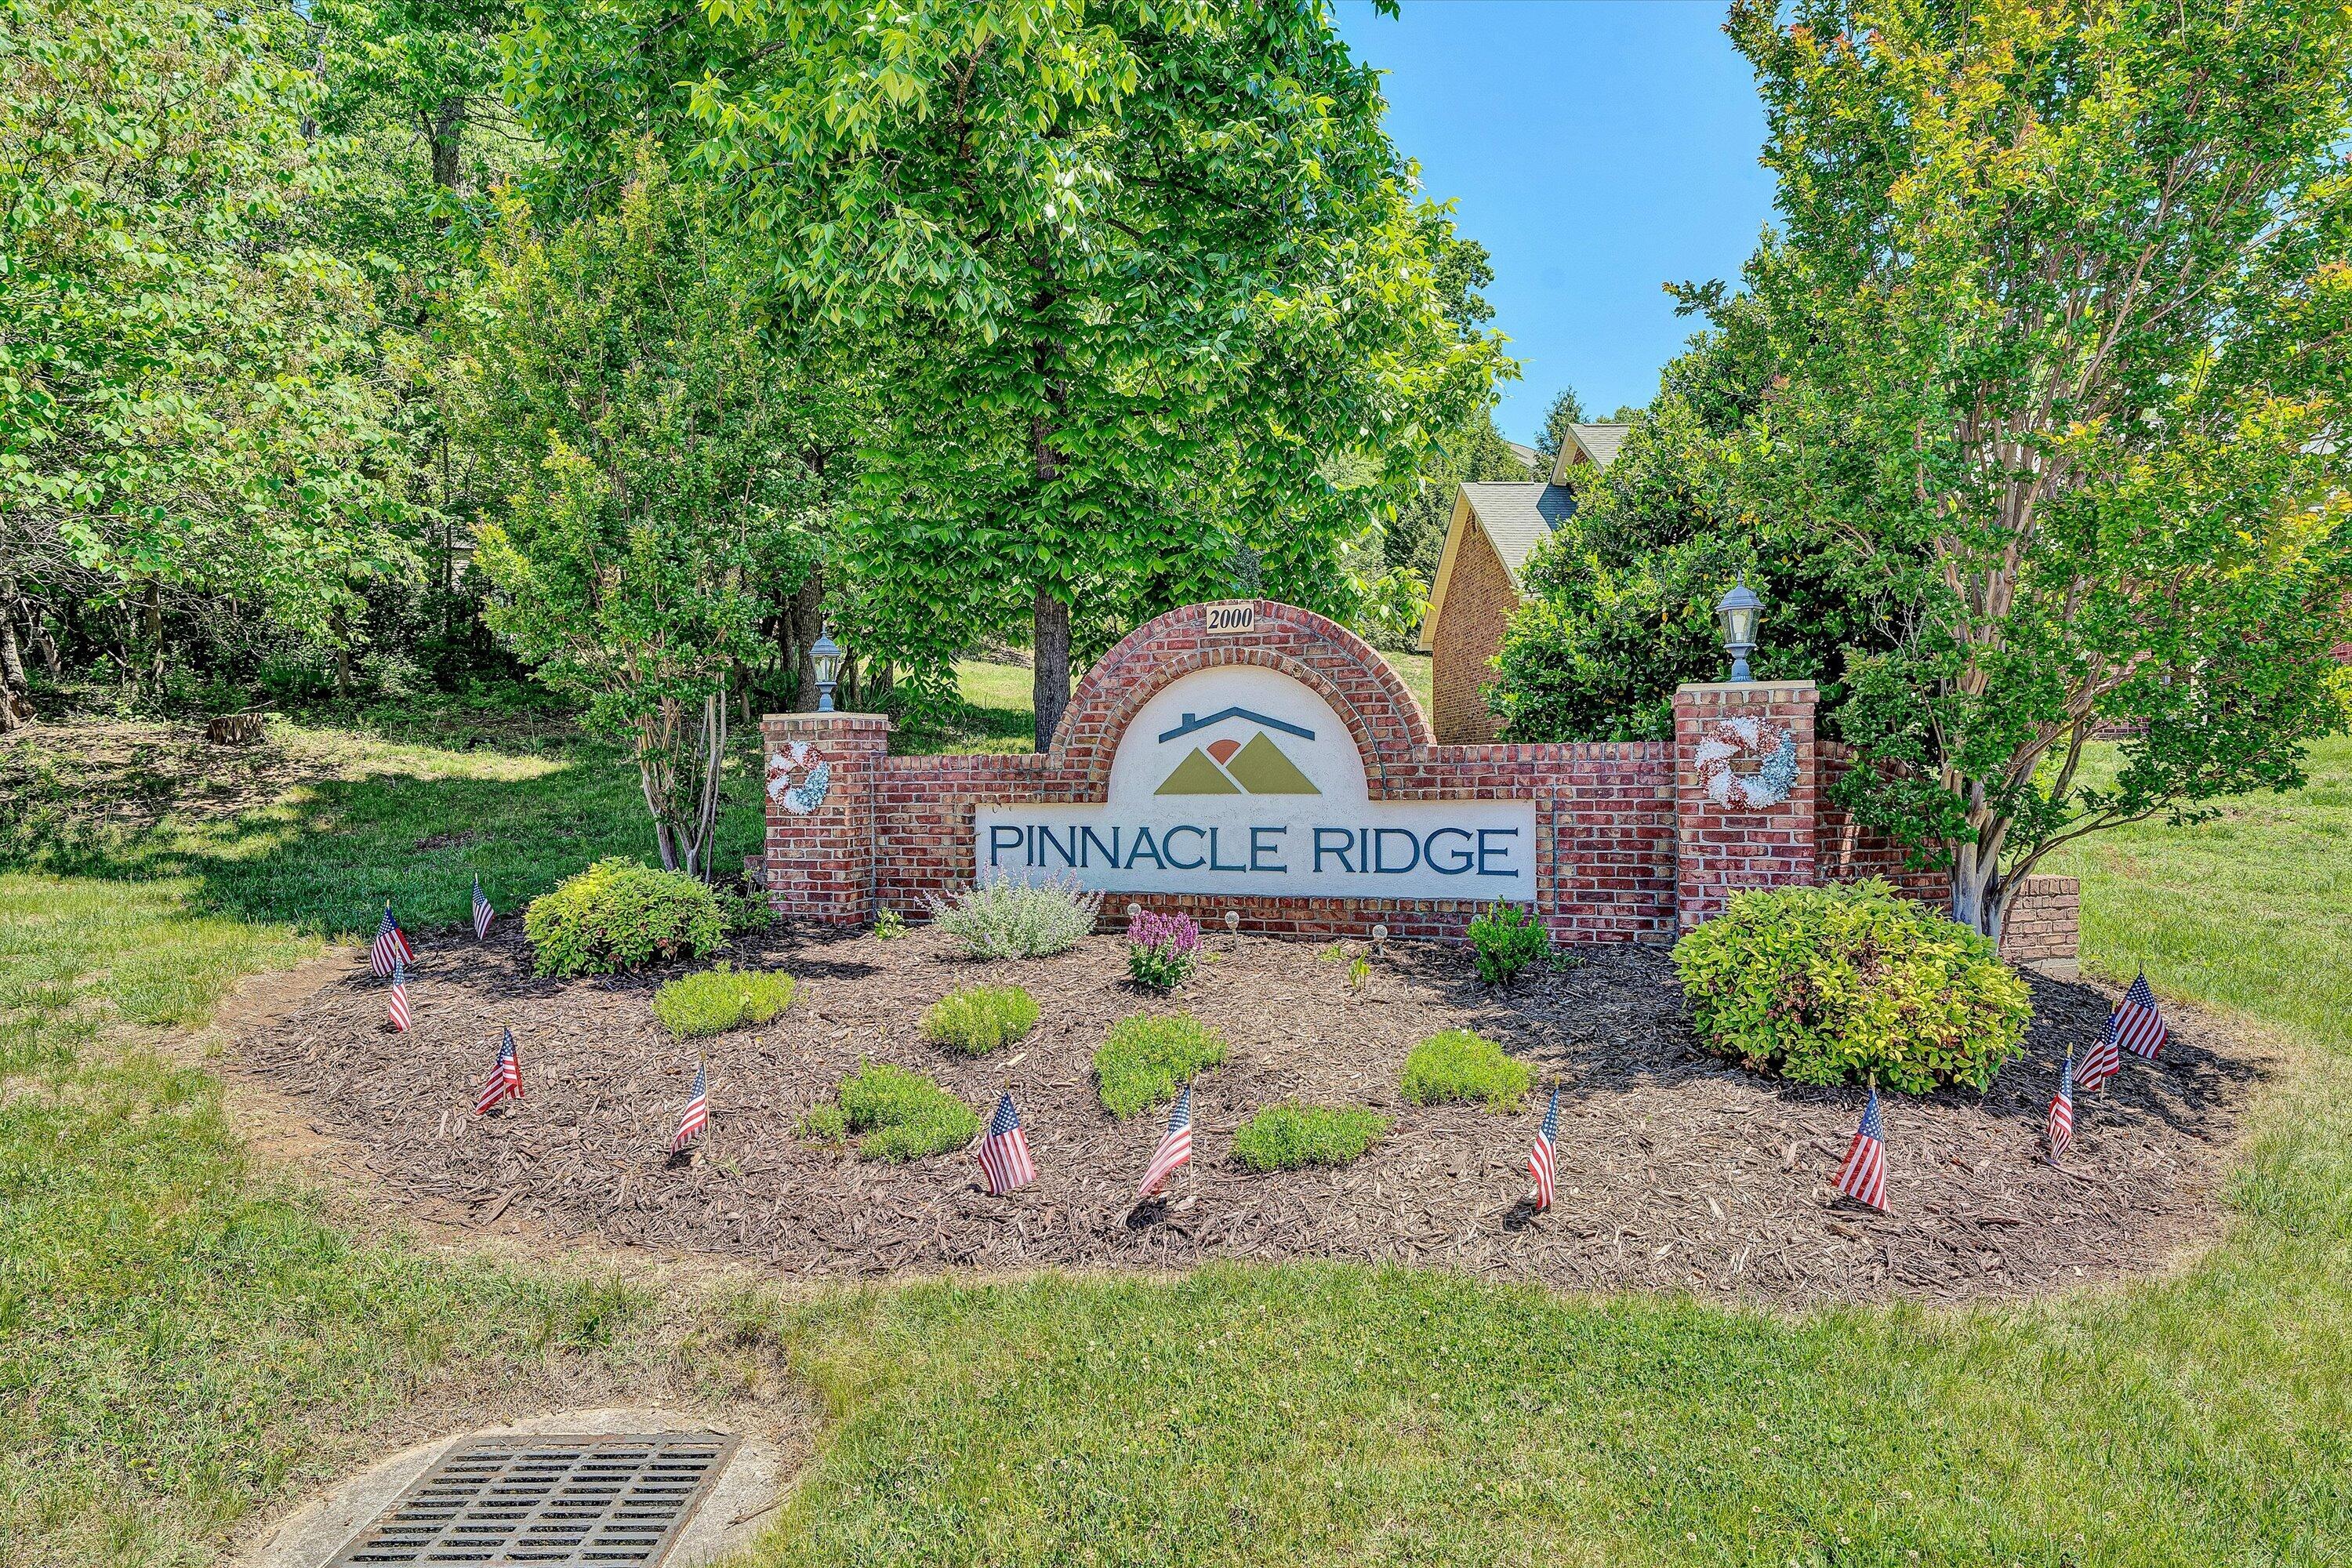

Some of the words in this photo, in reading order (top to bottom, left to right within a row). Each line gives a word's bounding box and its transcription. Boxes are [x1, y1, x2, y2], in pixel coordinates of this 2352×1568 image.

[1208, 608, 1253, 629] 2000
[990, 825, 1287, 873] PINNACLE
[1313, 827, 1519, 877] RIDGE
